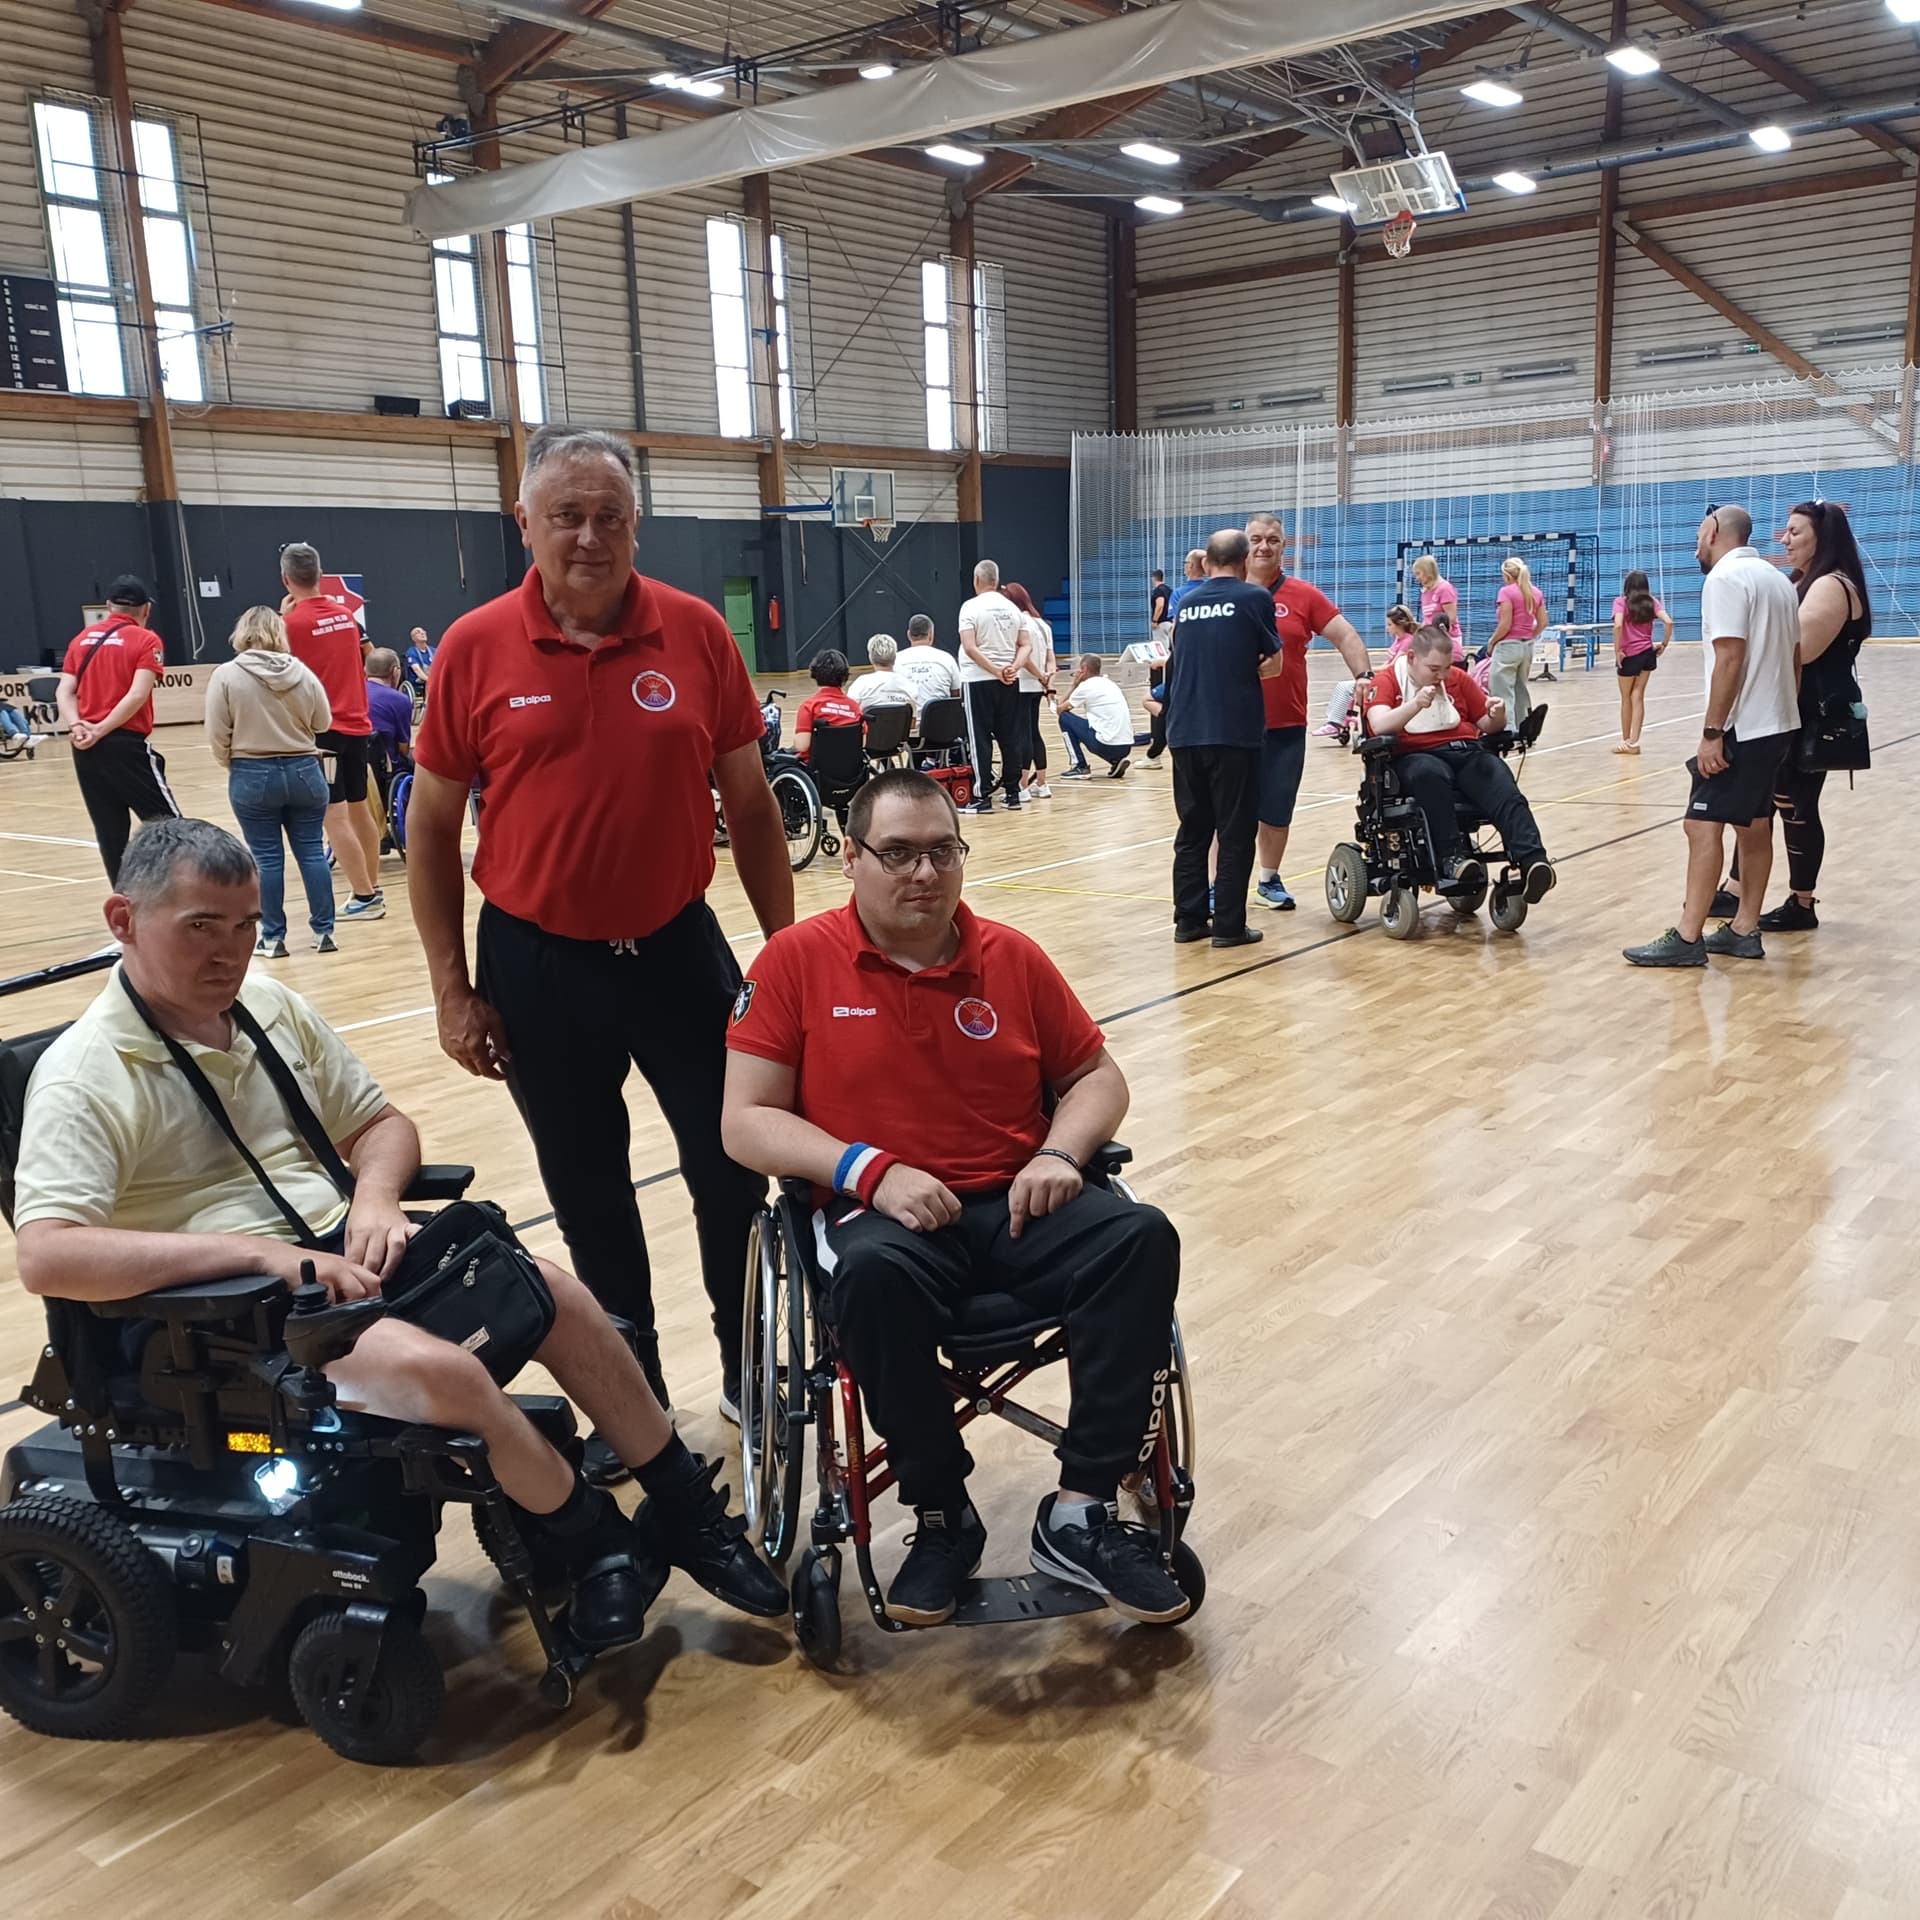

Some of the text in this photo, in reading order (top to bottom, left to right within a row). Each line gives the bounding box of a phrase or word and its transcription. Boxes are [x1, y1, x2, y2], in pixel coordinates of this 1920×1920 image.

[1179, 602, 1236, 623] SUDAC
[525, 695, 552, 705] alpas
[849, 1006, 877, 1016] alpas
[1138, 1369, 1169, 1463] alpas
